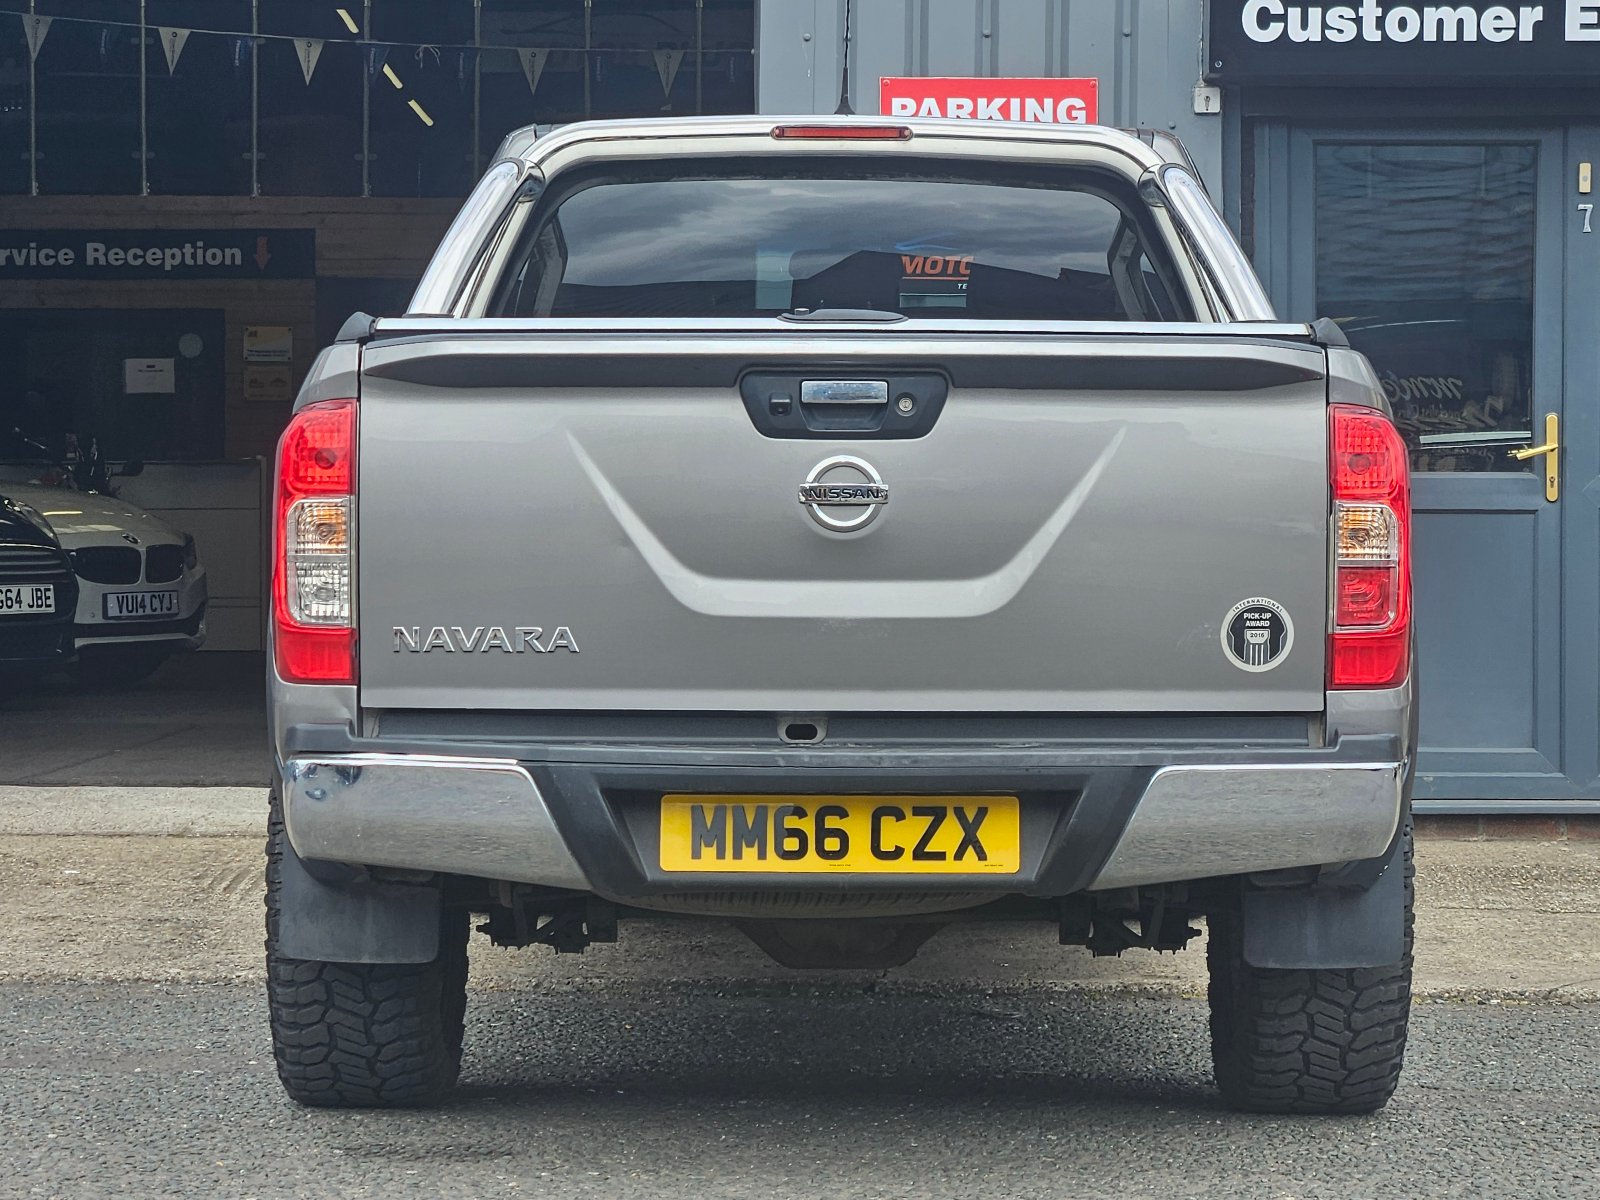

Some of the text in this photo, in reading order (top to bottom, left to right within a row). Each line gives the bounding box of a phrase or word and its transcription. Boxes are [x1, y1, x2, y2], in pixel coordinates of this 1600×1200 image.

[1241, 0, 1600, 43] Customer E
[891, 97, 1087, 124] PARKING
[1577, 204, 1594, 233] 7
[86, 241, 242, 271] Reception
[808, 488, 880, 500] NISSAN
[28, 587, 52, 609] JBE
[150, 593, 173, 613] CYJ
[1232, 599, 1284, 613] INTERNATIONAL
[392, 625, 581, 653] NAVARA
[690, 804, 989, 862] MM66 CZX
